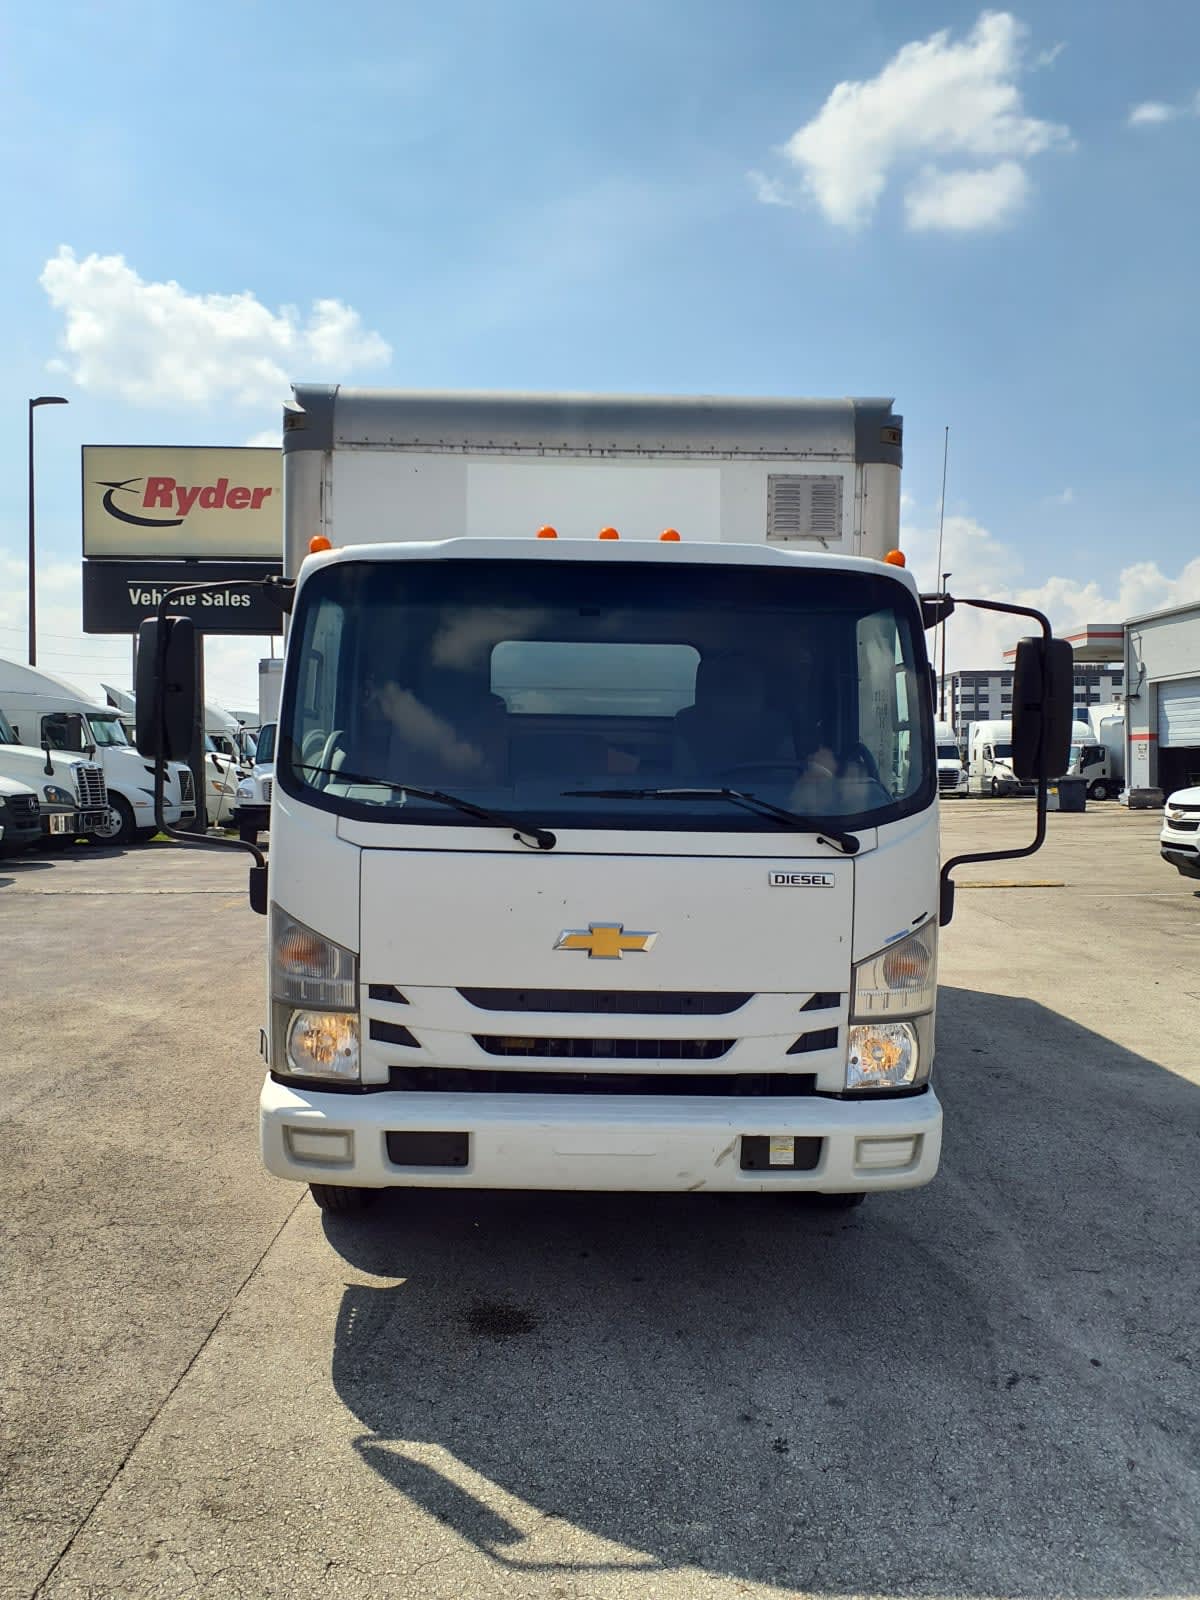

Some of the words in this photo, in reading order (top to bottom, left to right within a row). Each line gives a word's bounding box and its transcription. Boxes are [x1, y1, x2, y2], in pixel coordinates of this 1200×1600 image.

[142, 477, 272, 516] Ryder
[201, 590, 251, 607] Sales
[774, 874, 831, 885] DIESEL
